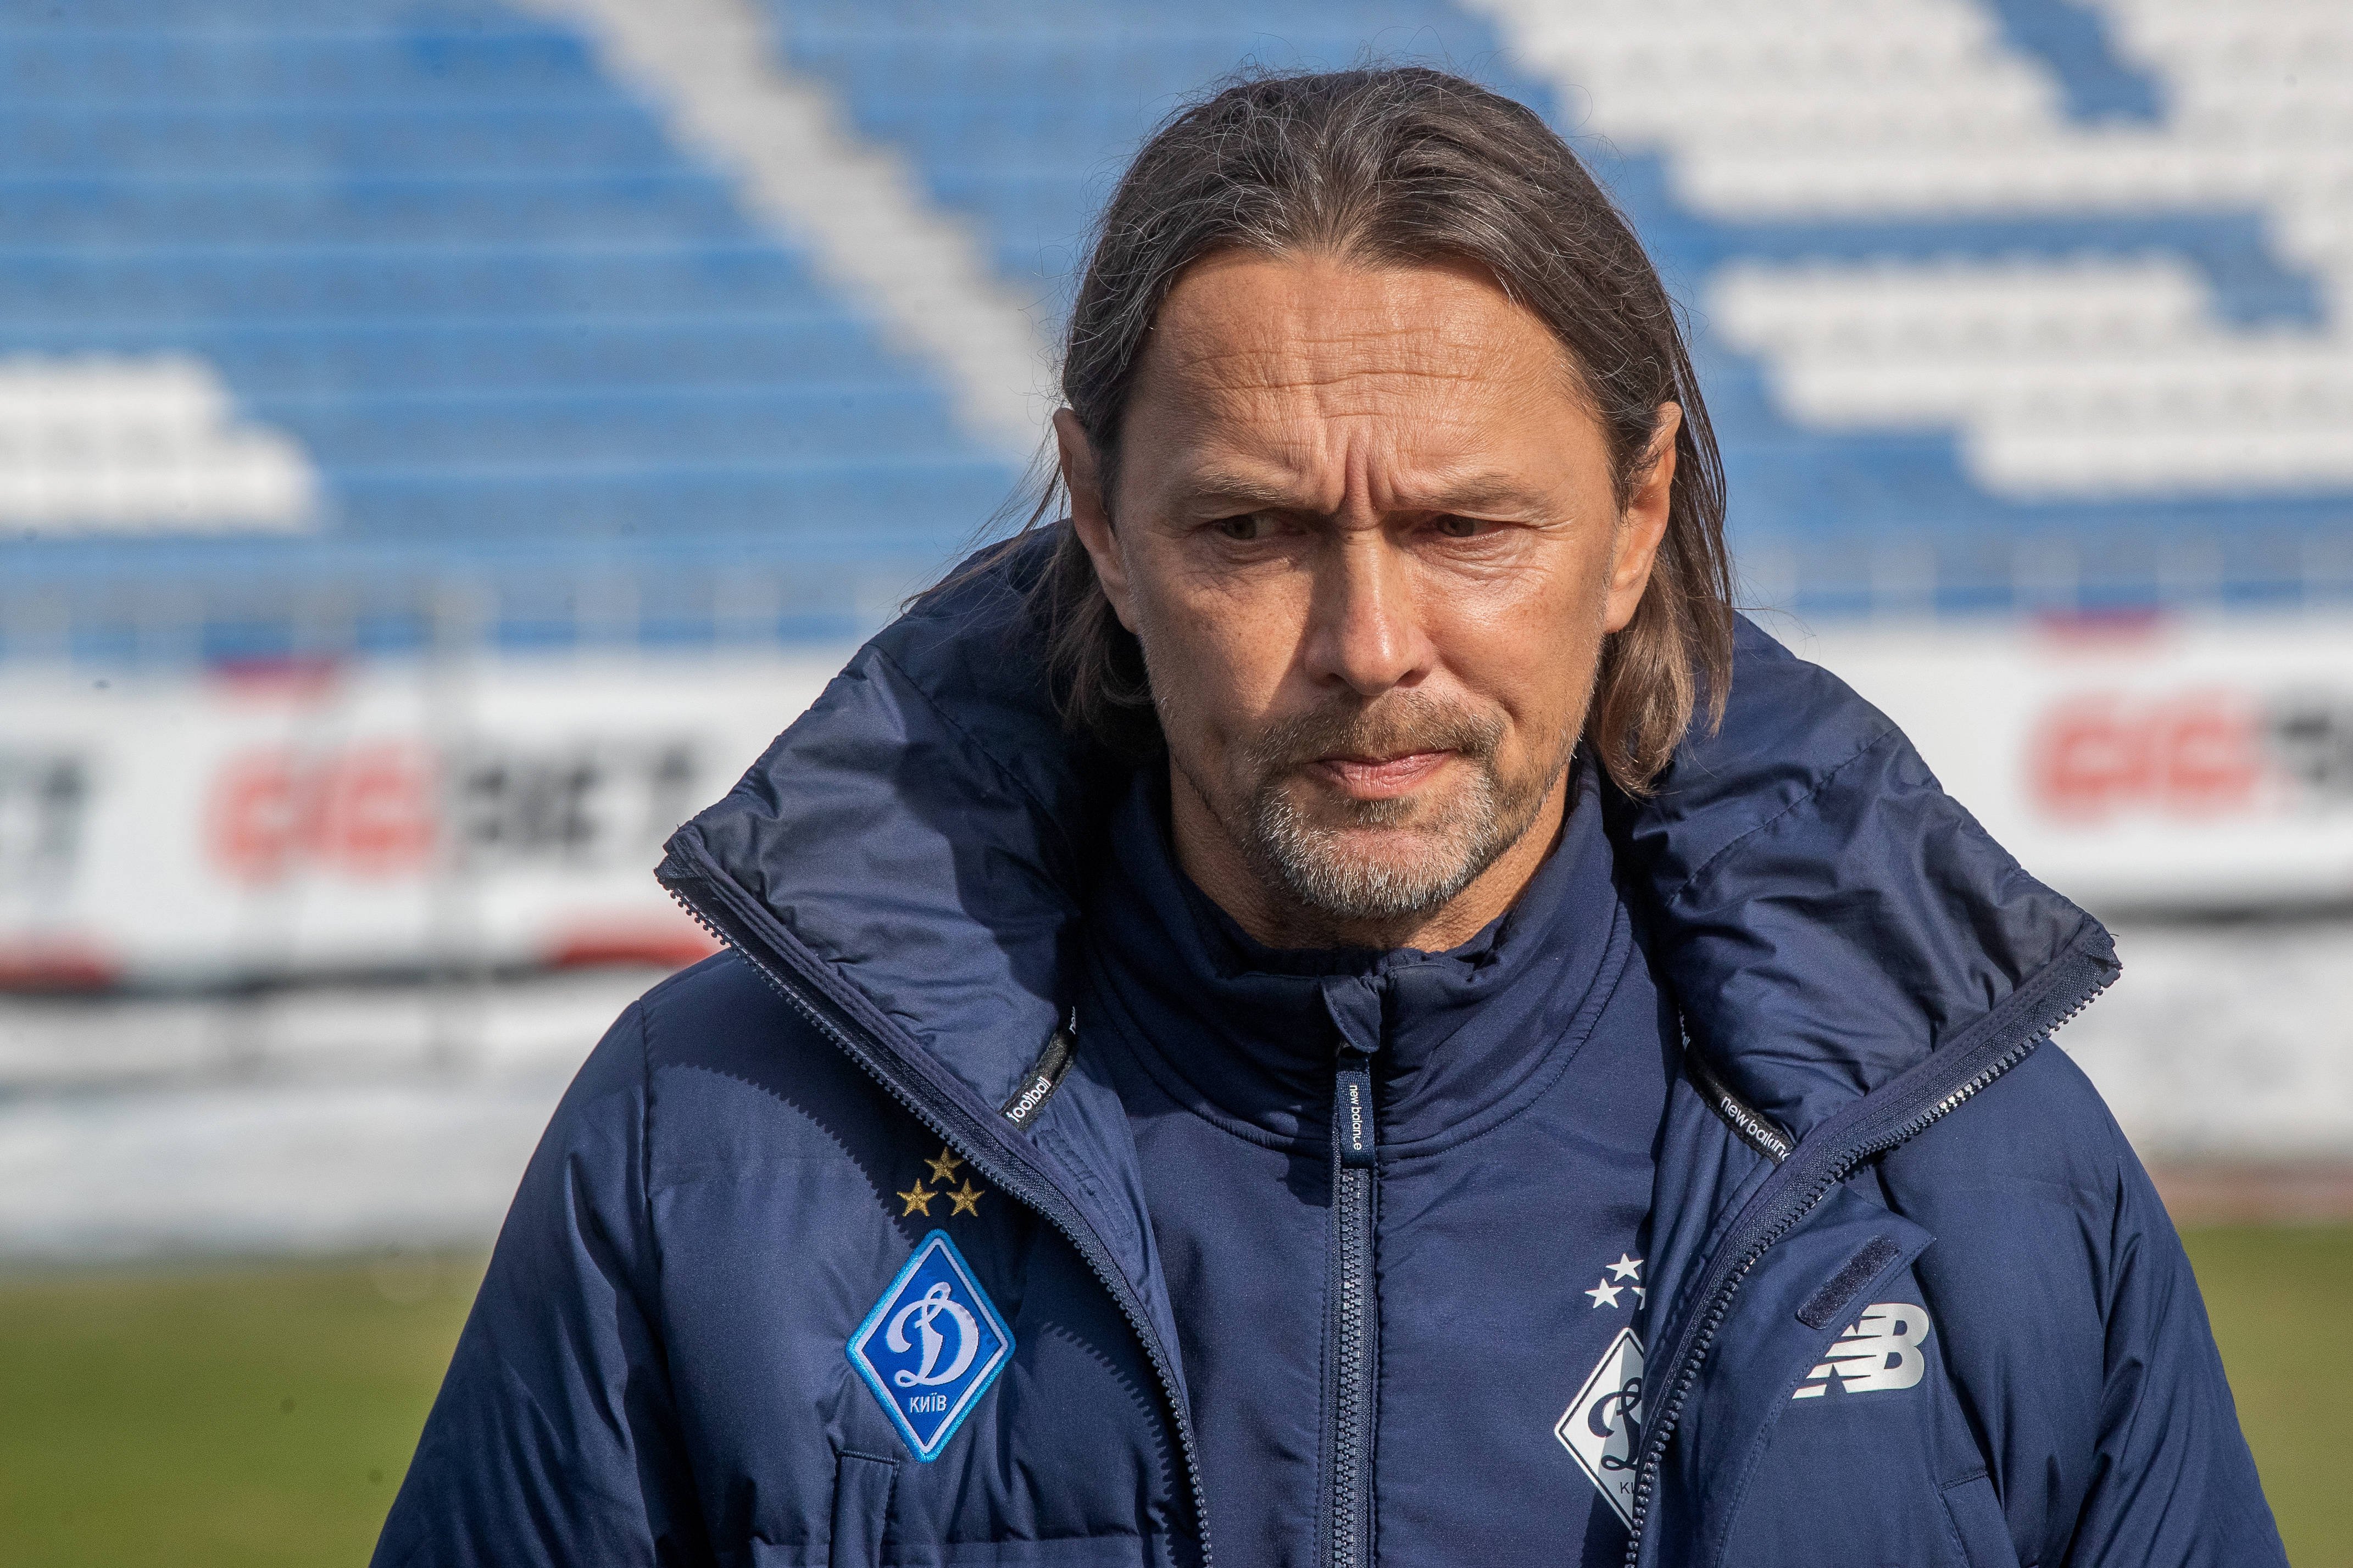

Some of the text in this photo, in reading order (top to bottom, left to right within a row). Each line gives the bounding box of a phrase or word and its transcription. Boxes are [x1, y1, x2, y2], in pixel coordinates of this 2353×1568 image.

[1006, 1076, 1052, 1123] football
[1349, 1085, 1362, 1151] new balance
[1721, 1096, 1749, 1127] new
[910, 1392, 947, 1413] КИЇВ
